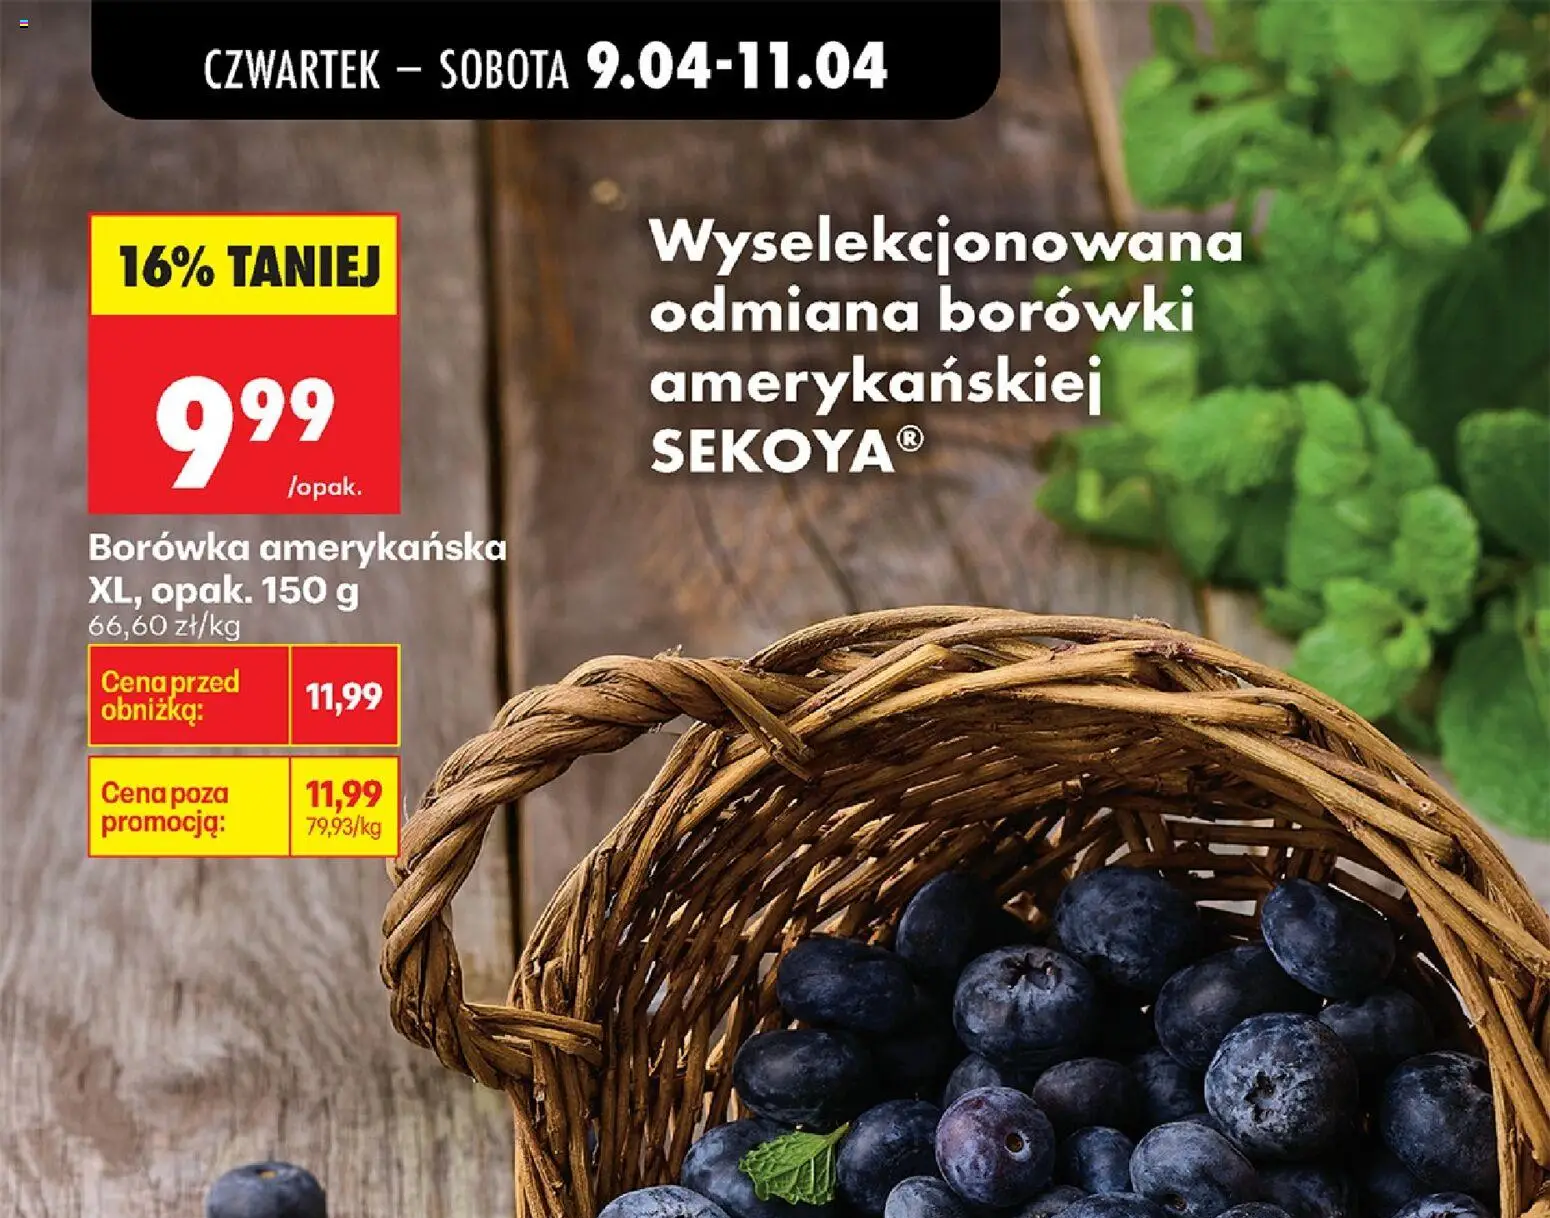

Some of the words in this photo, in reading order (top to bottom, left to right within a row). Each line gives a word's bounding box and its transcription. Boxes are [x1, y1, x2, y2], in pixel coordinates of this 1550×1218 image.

[203, 48, 380, 91] CZWARTEK
[440, 48, 570, 91] SOBOTA
[586, 39, 888, 91] 9.04-11.04
[648, 213, 1243, 277] Wyselekcjonowana
[119, 244, 214, 289] 16%
[227, 244, 381, 289] TANIEJ
[649, 283, 919, 334] odmiana
[939, 283, 1194, 334] borówki
[649, 354, 1102, 417] amerykańskiej
[288, 475, 362, 500] /opak.
[89, 531, 249, 562] Borówka
[259, 531, 506, 570] amerykańska
[89, 576, 142, 610] XL,
[151, 574, 253, 611] opak.
[262, 576, 327, 605] 150
[336, 583, 360, 612] g
[89, 615, 167, 641] 66,60
[175, 611, 240, 641] zł/kg
[101, 670, 166, 695] Cena
[171, 668, 240, 702] przed
[306, 682, 383, 716] 11,99
[101, 694, 204, 727] obniżką:
[101, 781, 166, 805] Cena
[171, 785, 229, 812] poza
[306, 780, 383, 812] 11,99
[101, 809, 225, 838] promocją:
[306, 816, 382, 840] 79,93/kg
